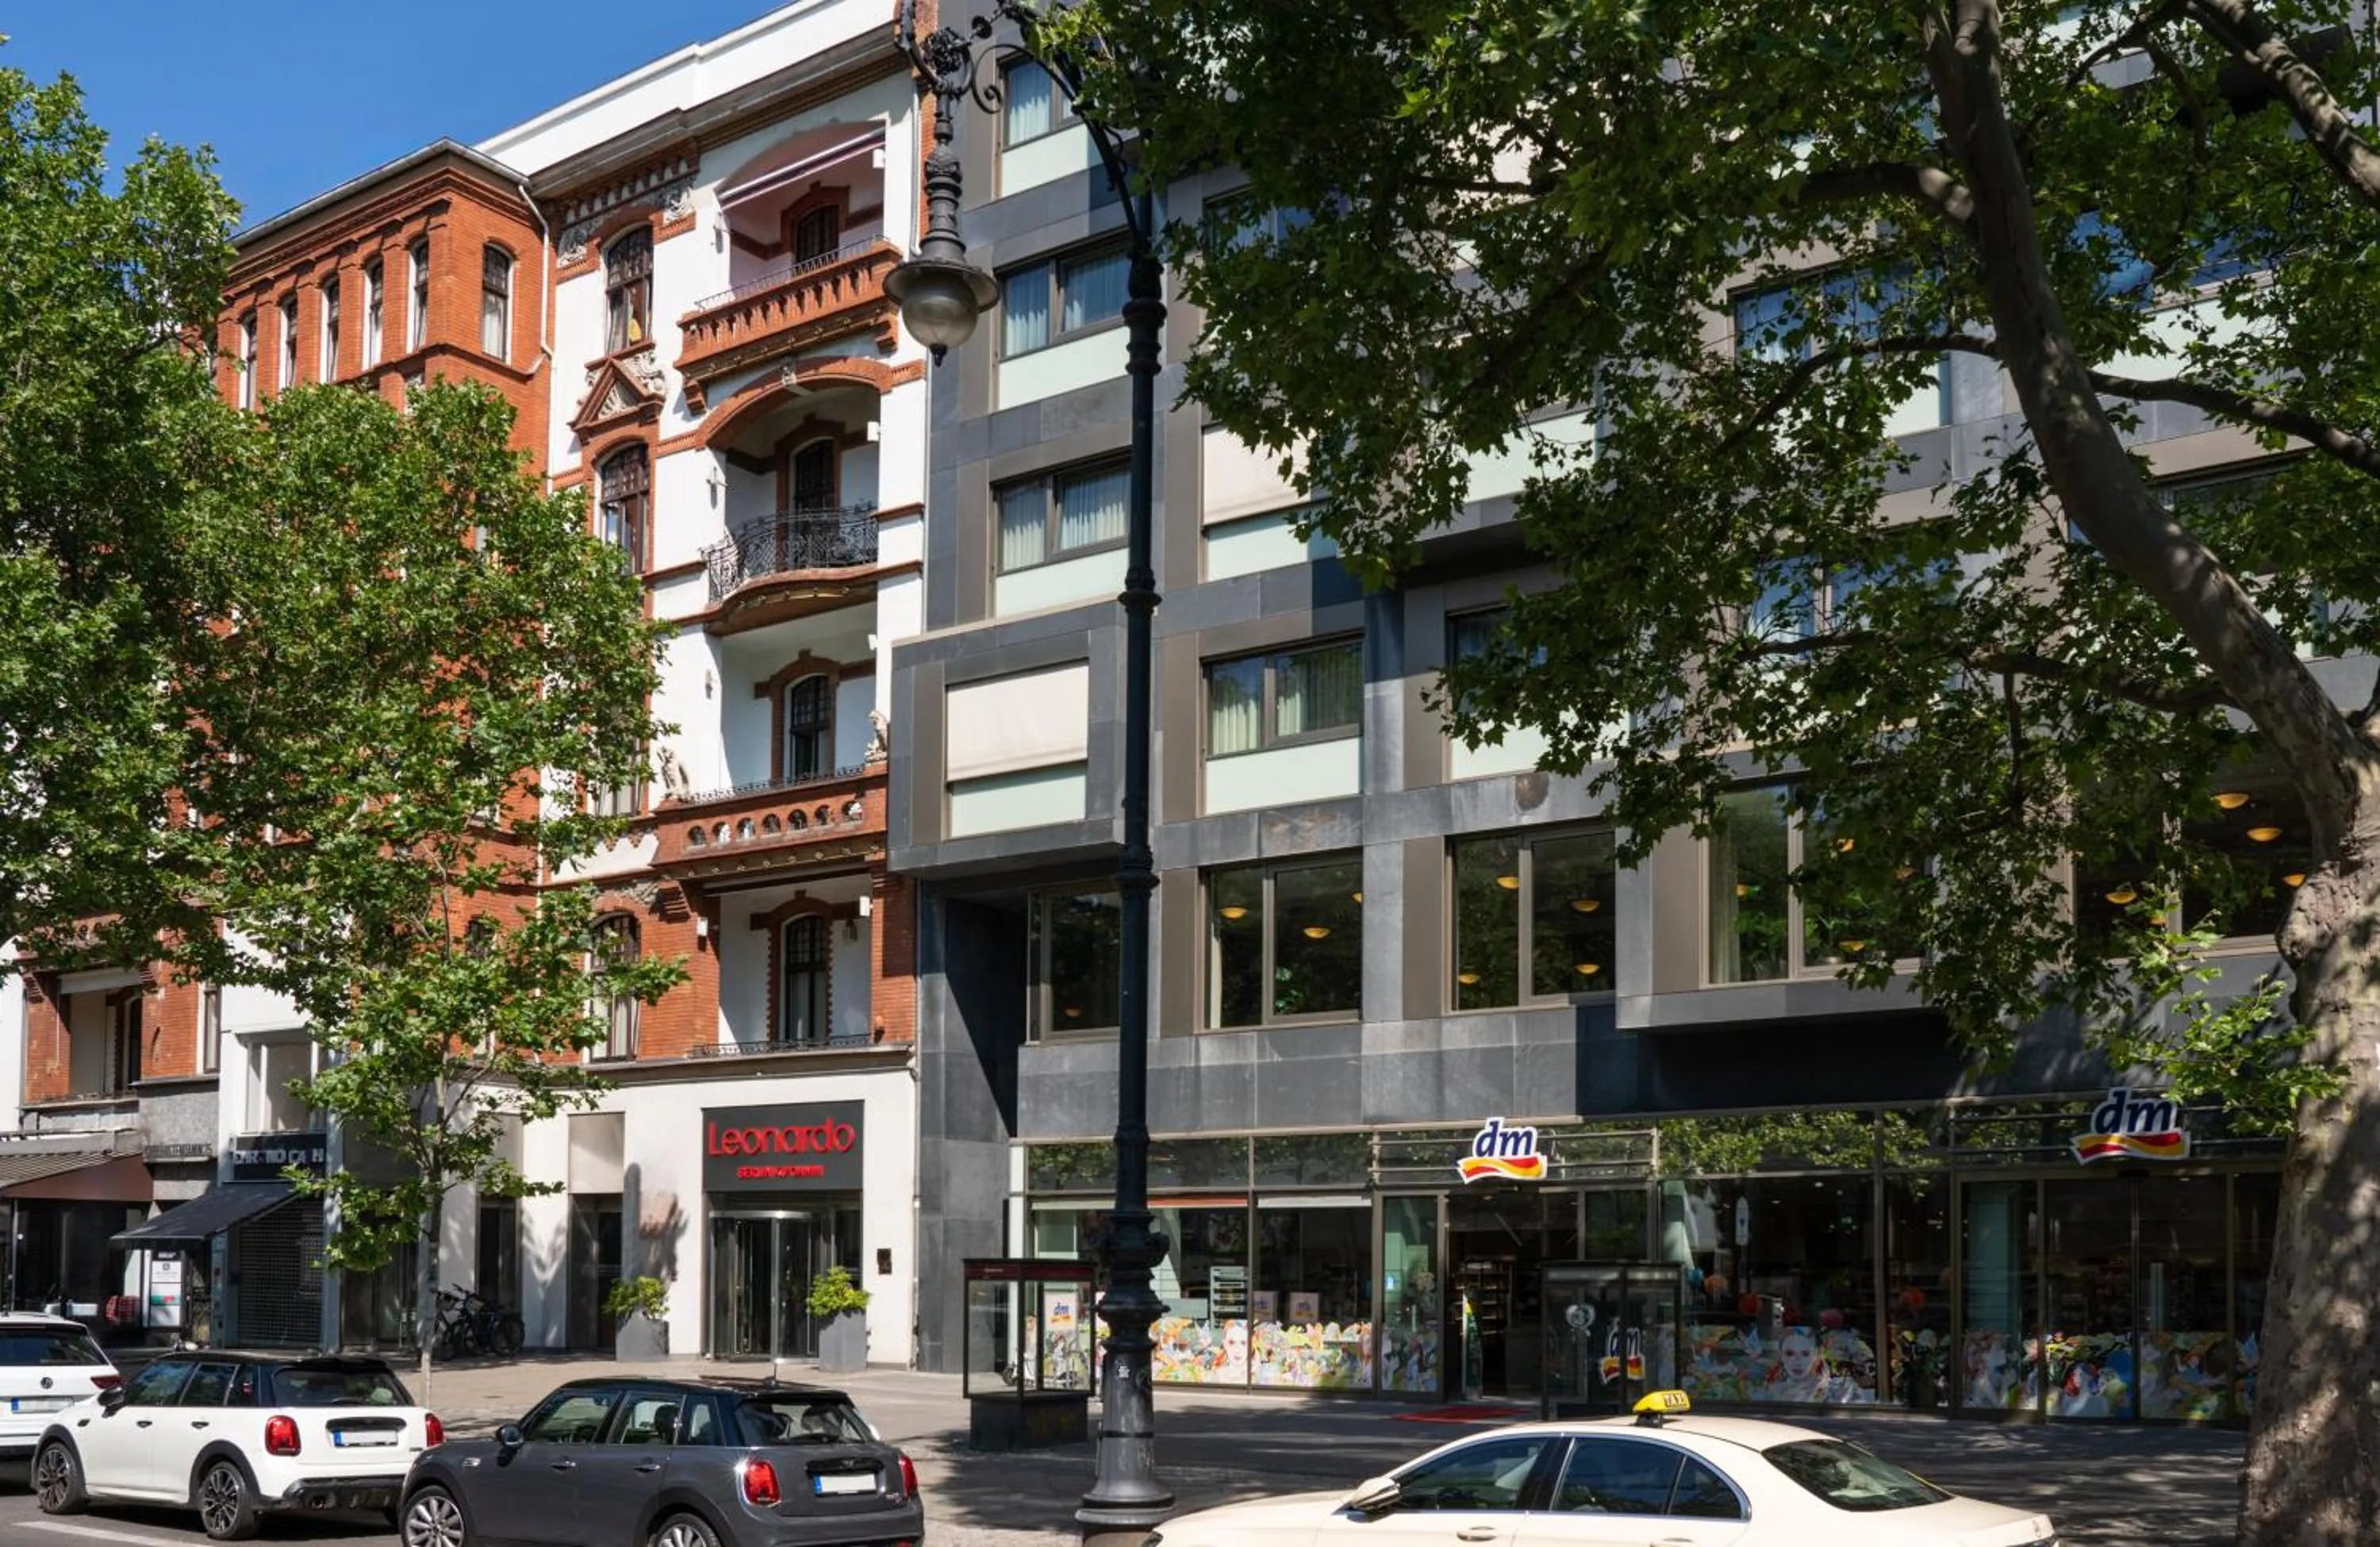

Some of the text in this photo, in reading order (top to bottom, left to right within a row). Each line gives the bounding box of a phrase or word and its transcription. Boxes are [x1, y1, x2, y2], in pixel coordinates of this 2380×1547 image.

[2095, 1091, 2172, 1134] dm
[708, 1117, 856, 1155] Leonardo
[1476, 1121, 1533, 1157] dm
